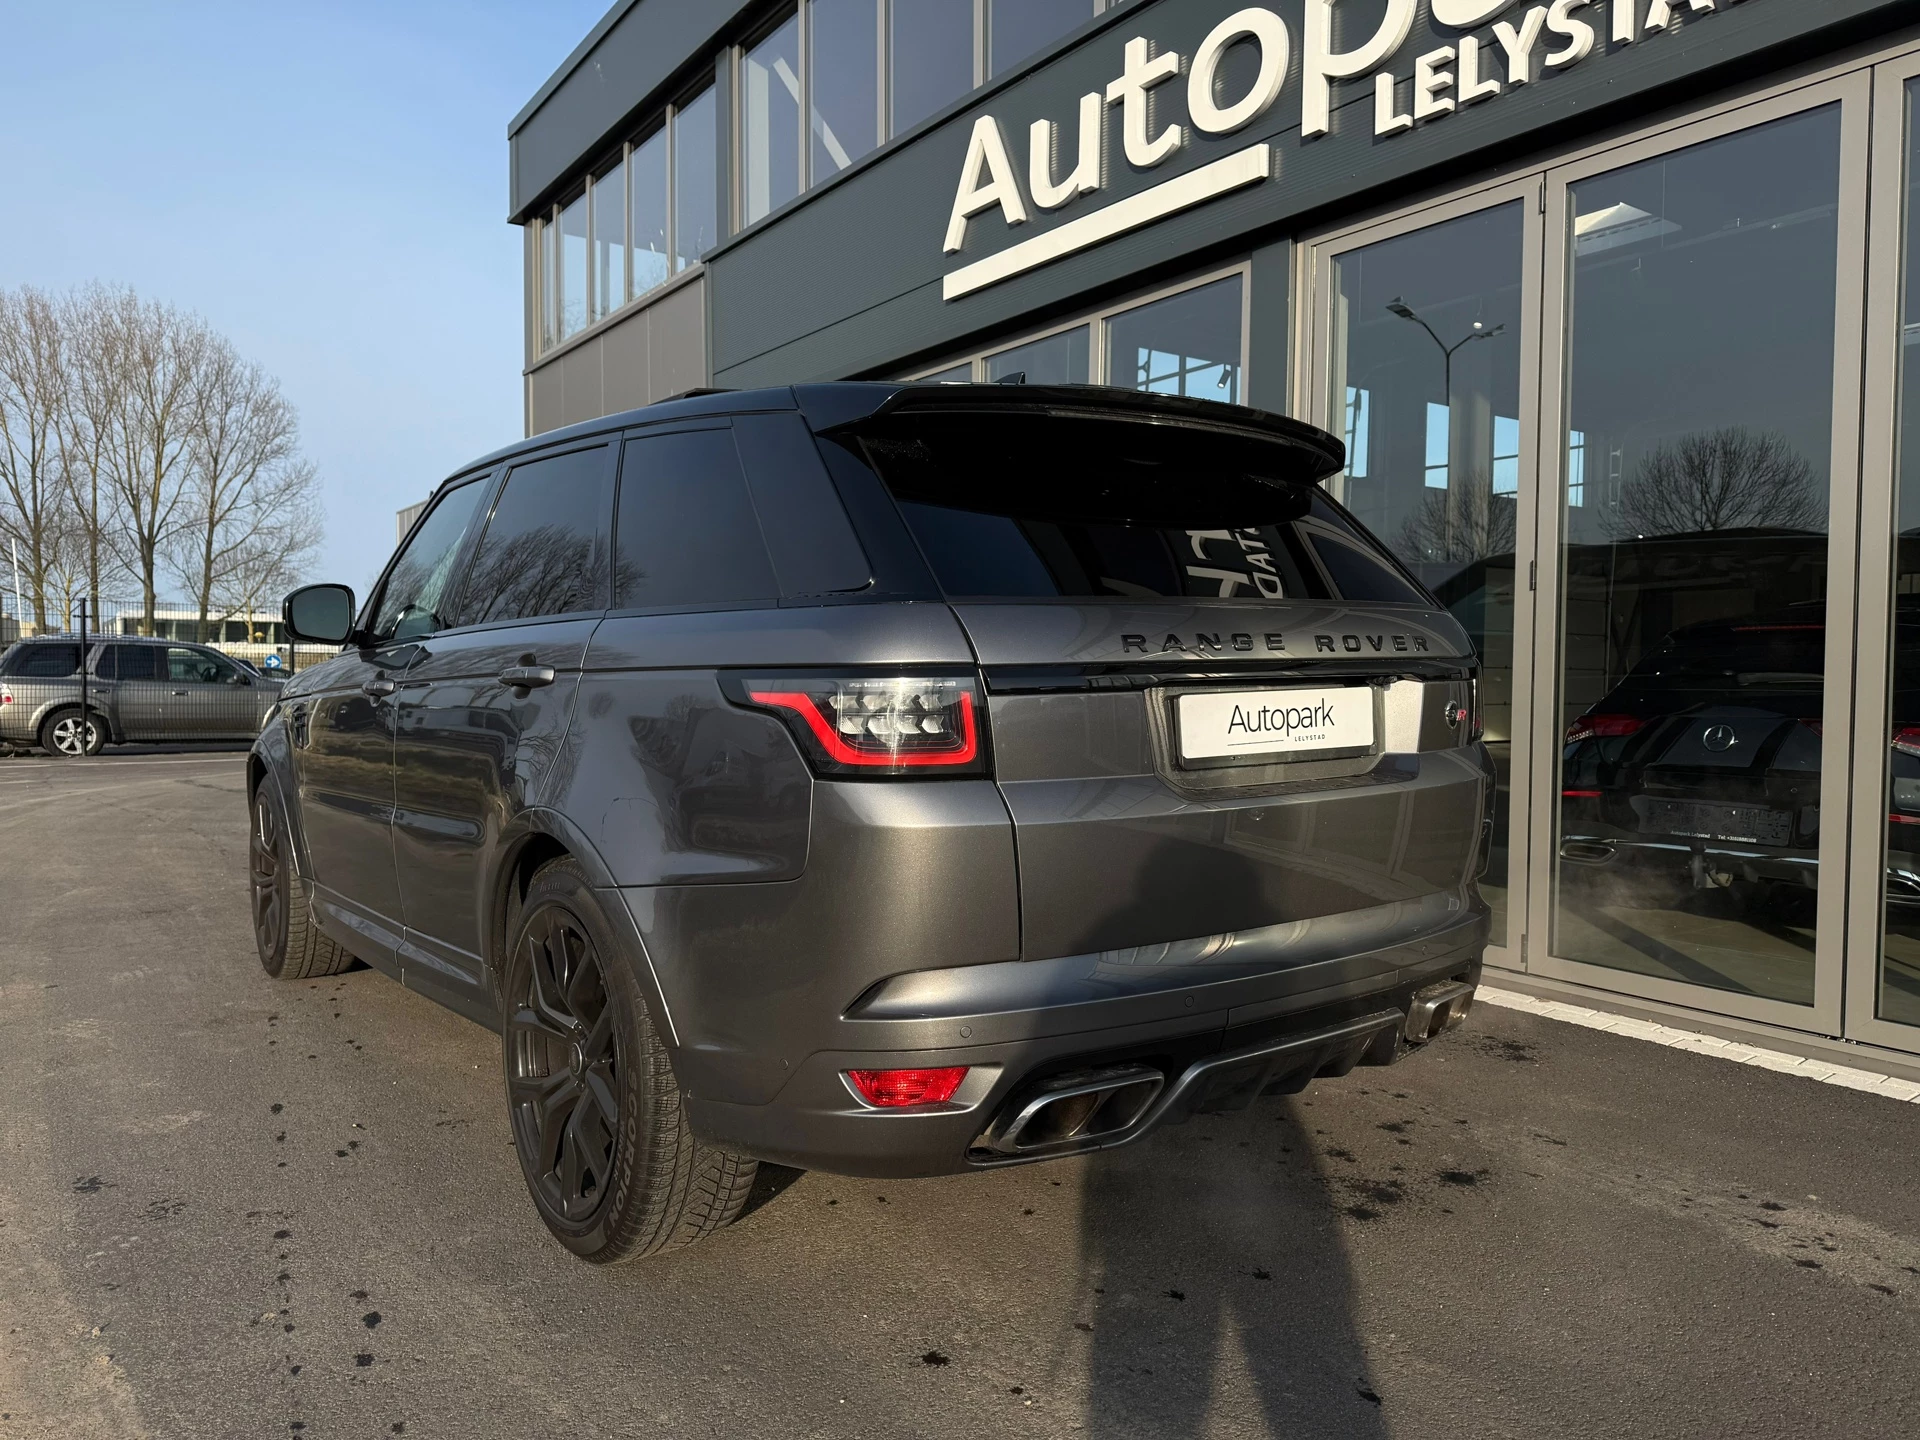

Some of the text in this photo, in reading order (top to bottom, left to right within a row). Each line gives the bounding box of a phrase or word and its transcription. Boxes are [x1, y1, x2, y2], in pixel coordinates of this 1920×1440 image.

[1374, 0, 1744, 136] LELYST
[942, 0, 1524, 254] Autop
[1120, 632, 1430, 653] RANGE ROVER
[1227, 698, 1336, 737] Autopark
[1294, 733, 1326, 742] LELYSTAD
[608, 1067, 638, 1229] SCORPION
